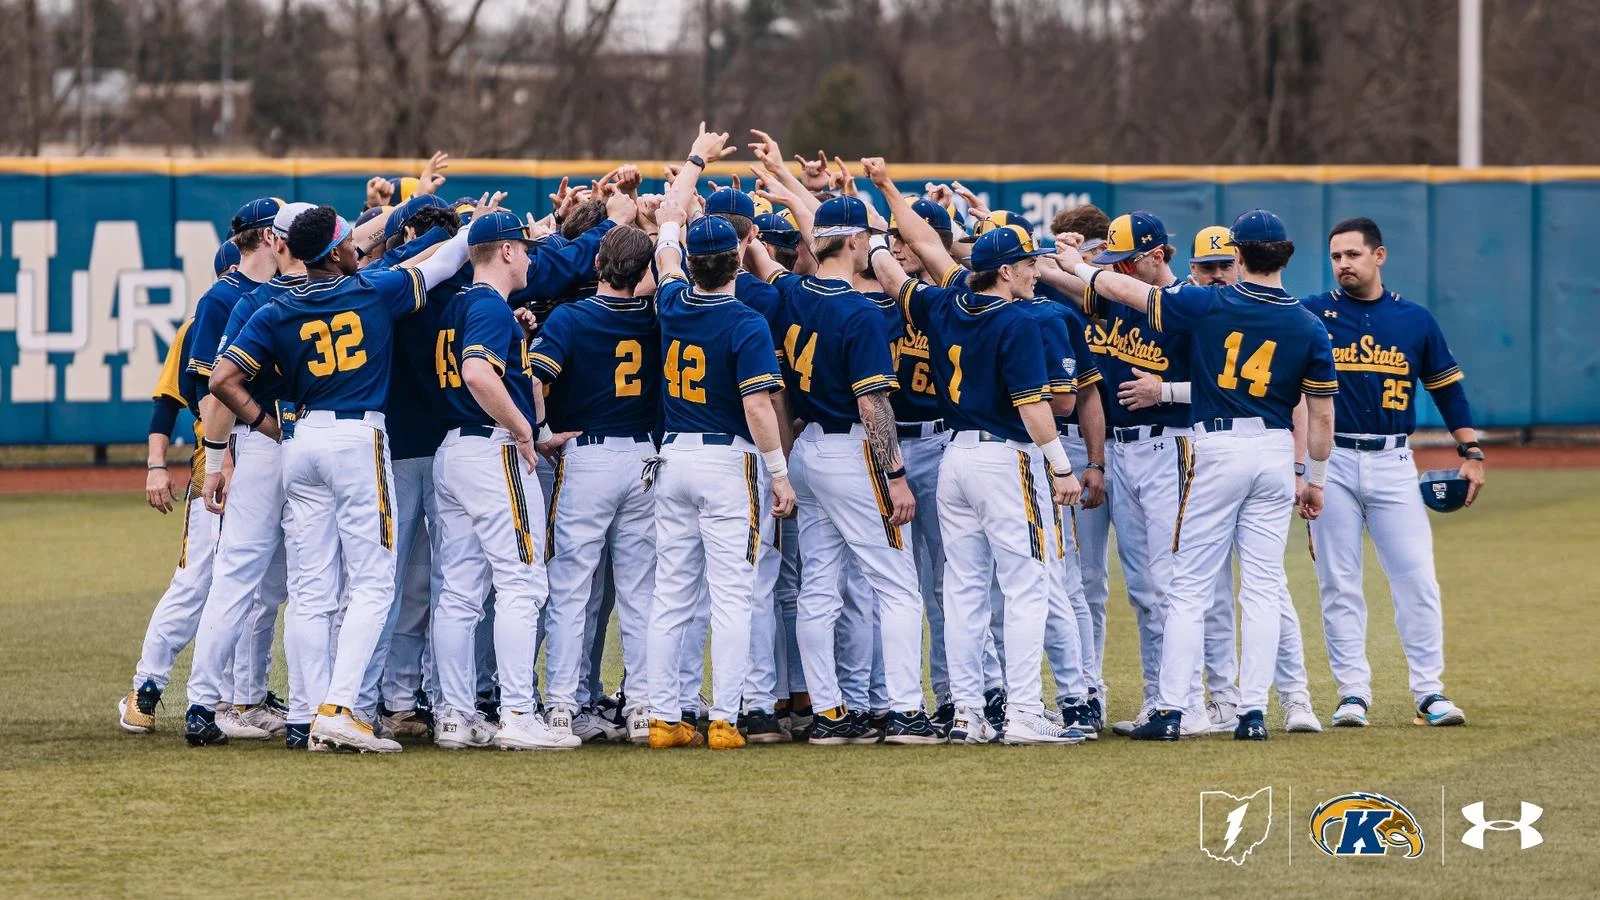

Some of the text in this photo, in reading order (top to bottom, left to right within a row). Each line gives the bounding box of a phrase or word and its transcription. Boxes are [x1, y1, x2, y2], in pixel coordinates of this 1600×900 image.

[1209, 236, 1221, 250] K
[299, 311, 367, 377] 32
[435, 328, 462, 388] 45
[614, 339, 642, 397] 2
[663, 339, 707, 404] 42
[1128, 327, 1163, 362] State
[1217, 331, 1277, 397] 14
[1328, 333, 1408, 368] ent State
[948, 344, 963, 404] 1
[1382, 378, 1412, 412] 25
